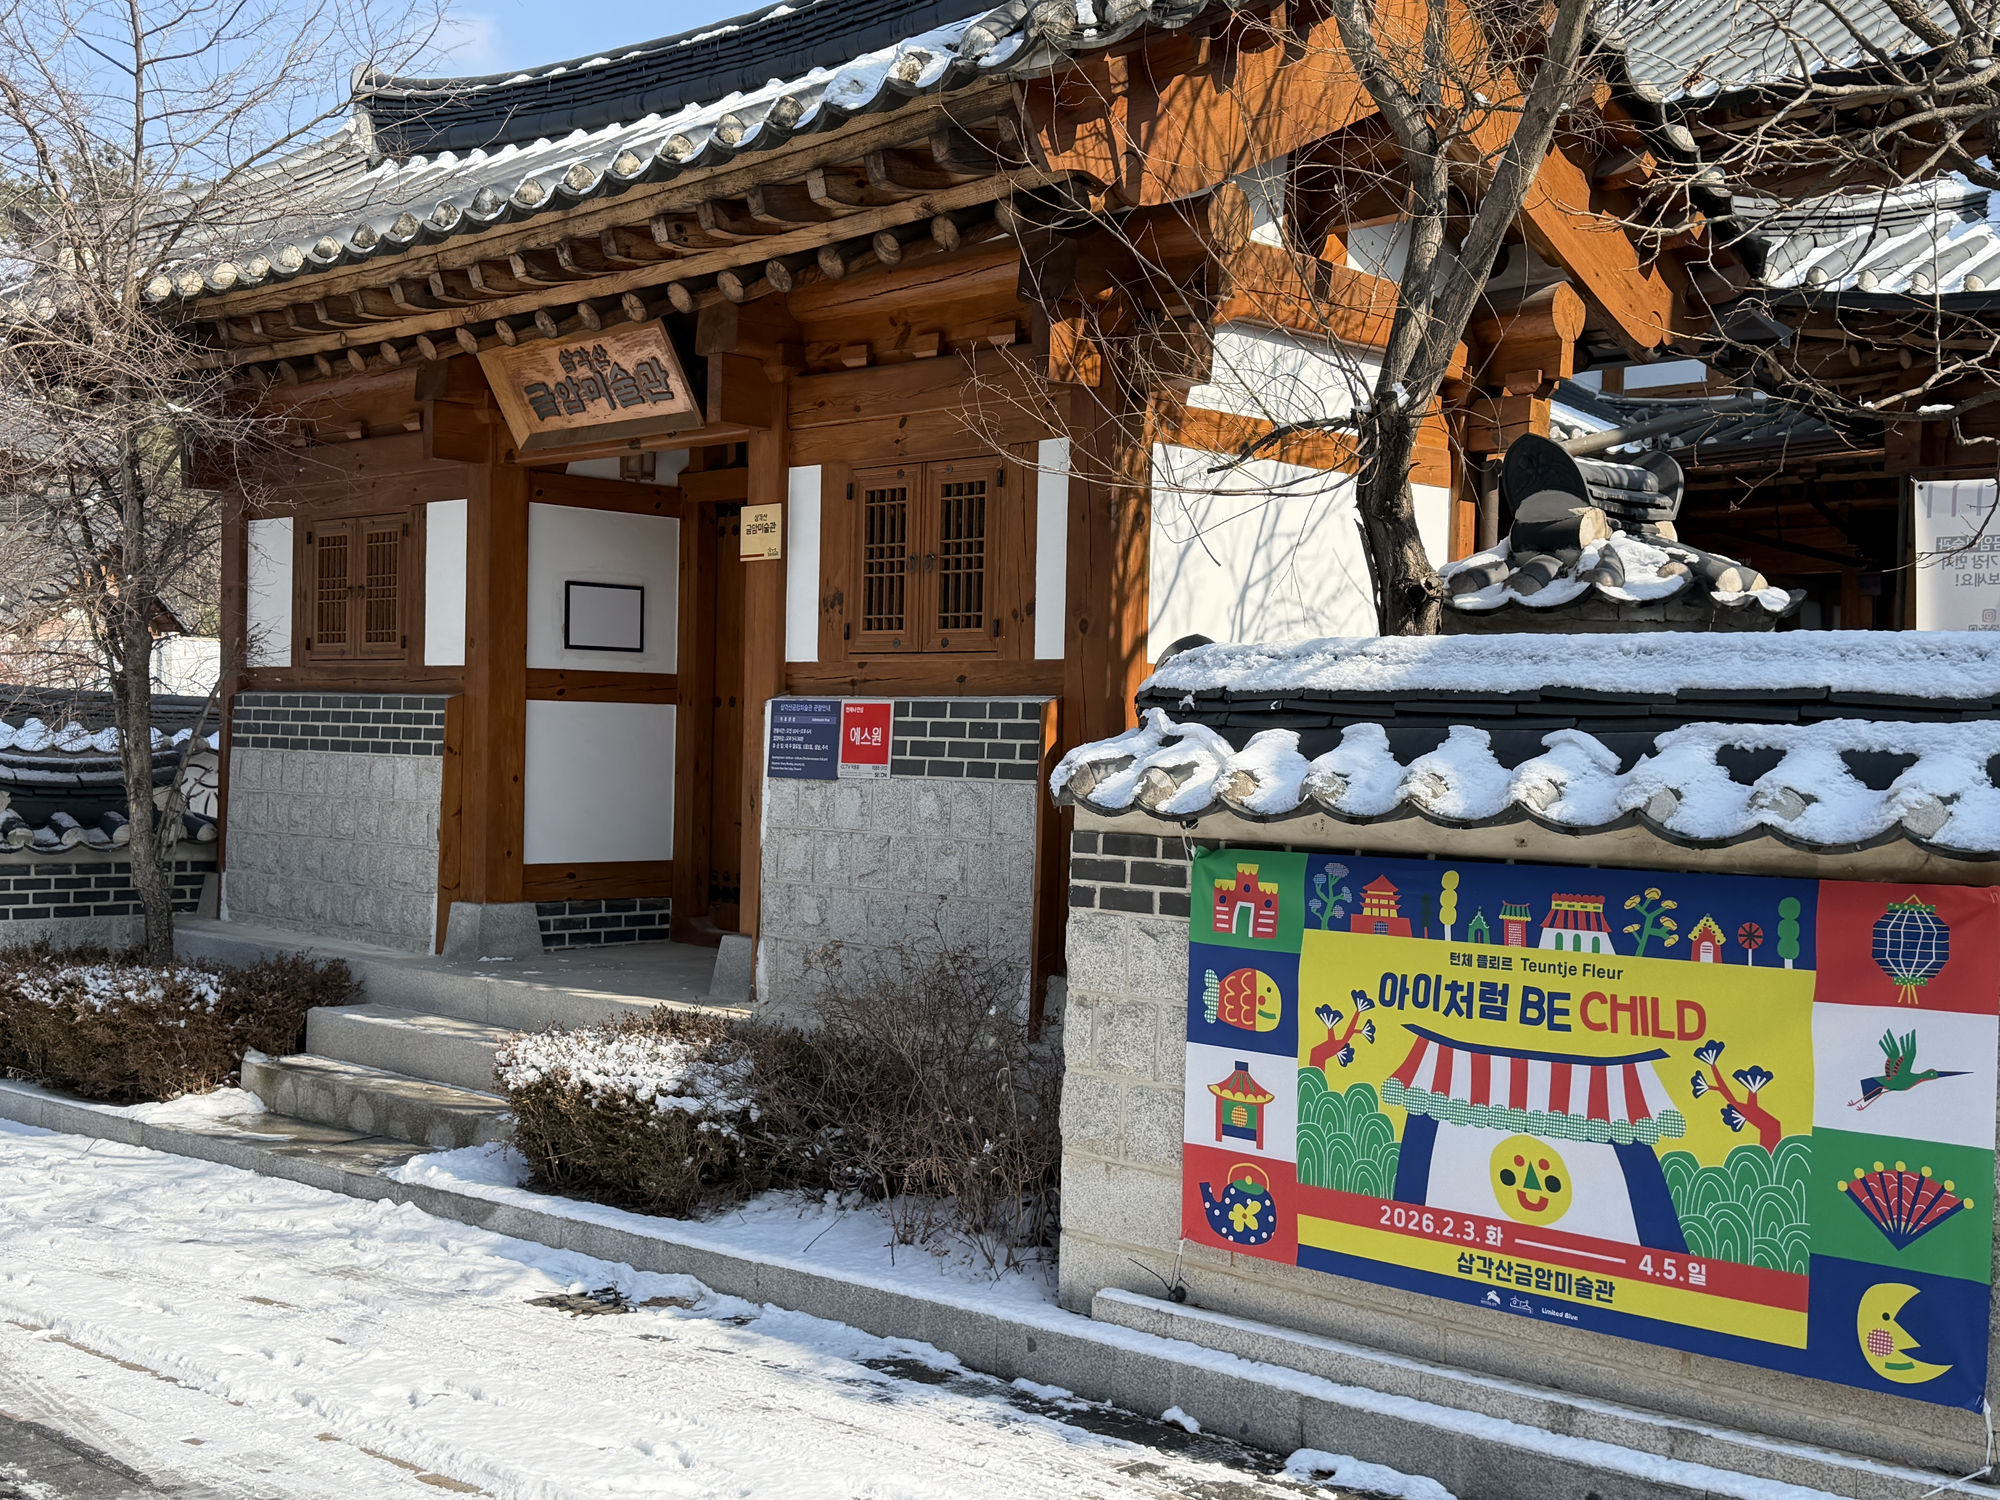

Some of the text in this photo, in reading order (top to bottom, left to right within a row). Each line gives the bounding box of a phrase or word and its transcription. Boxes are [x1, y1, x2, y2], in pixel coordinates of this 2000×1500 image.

[559, 343, 610, 373] 삼각산
[524, 356, 674, 421] 금암미술관
[746, 522, 777, 535] 금암미술관
[849, 726, 882, 746] 에스원
[1450, 952, 1624, 980] 턴체 플뢰르 Teuntje Fleur
[1378, 971, 1707, 1041] 아이처럼 BE CHILD
[1457, 1251, 1616, 1304] 삼각산금암미술관
